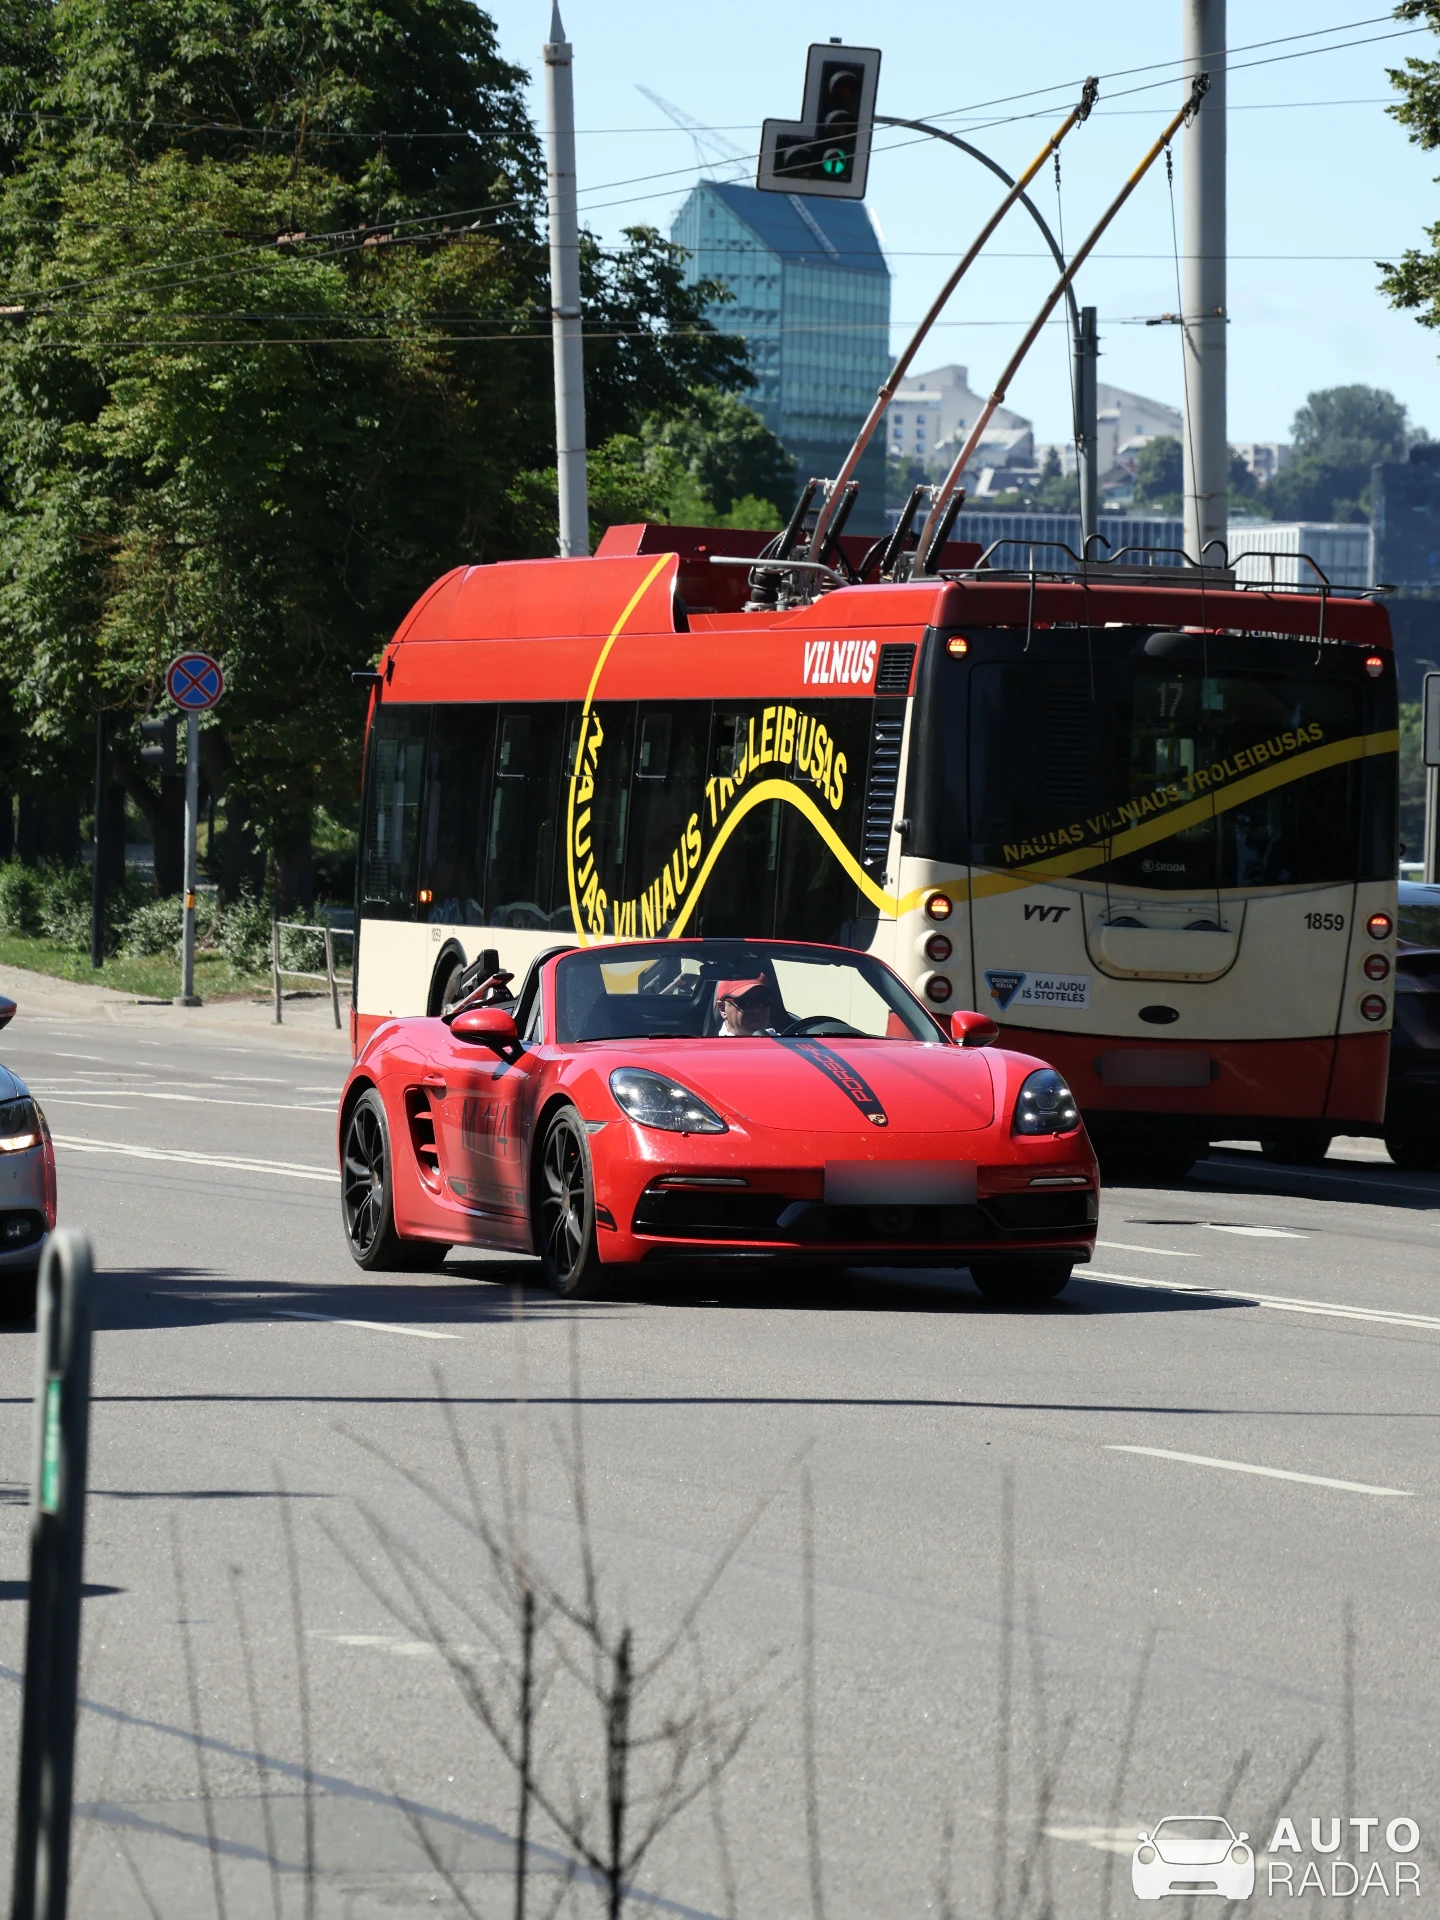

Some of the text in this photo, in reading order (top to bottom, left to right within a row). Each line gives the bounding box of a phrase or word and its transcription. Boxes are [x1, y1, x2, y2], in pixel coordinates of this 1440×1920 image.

[803, 640, 876, 684] VILNIUS
[1157, 682, 1183, 717] 17
[1002, 823, 1085, 863] NAUJAS
[1182, 722, 1323, 794] TROLEIBUSAS
[575, 711, 607, 942] NAUJAS
[614, 813, 702, 944] VILNIAUS
[1155, 861, 1186, 873] ŠKODA
[1303, 912, 1345, 931] 1859
[1022, 988, 1085, 1003] IŠ STOTELĖS
[1035, 980, 1086, 992] KAI JUDU
[795, 1043, 873, 1102] PORSCHE
